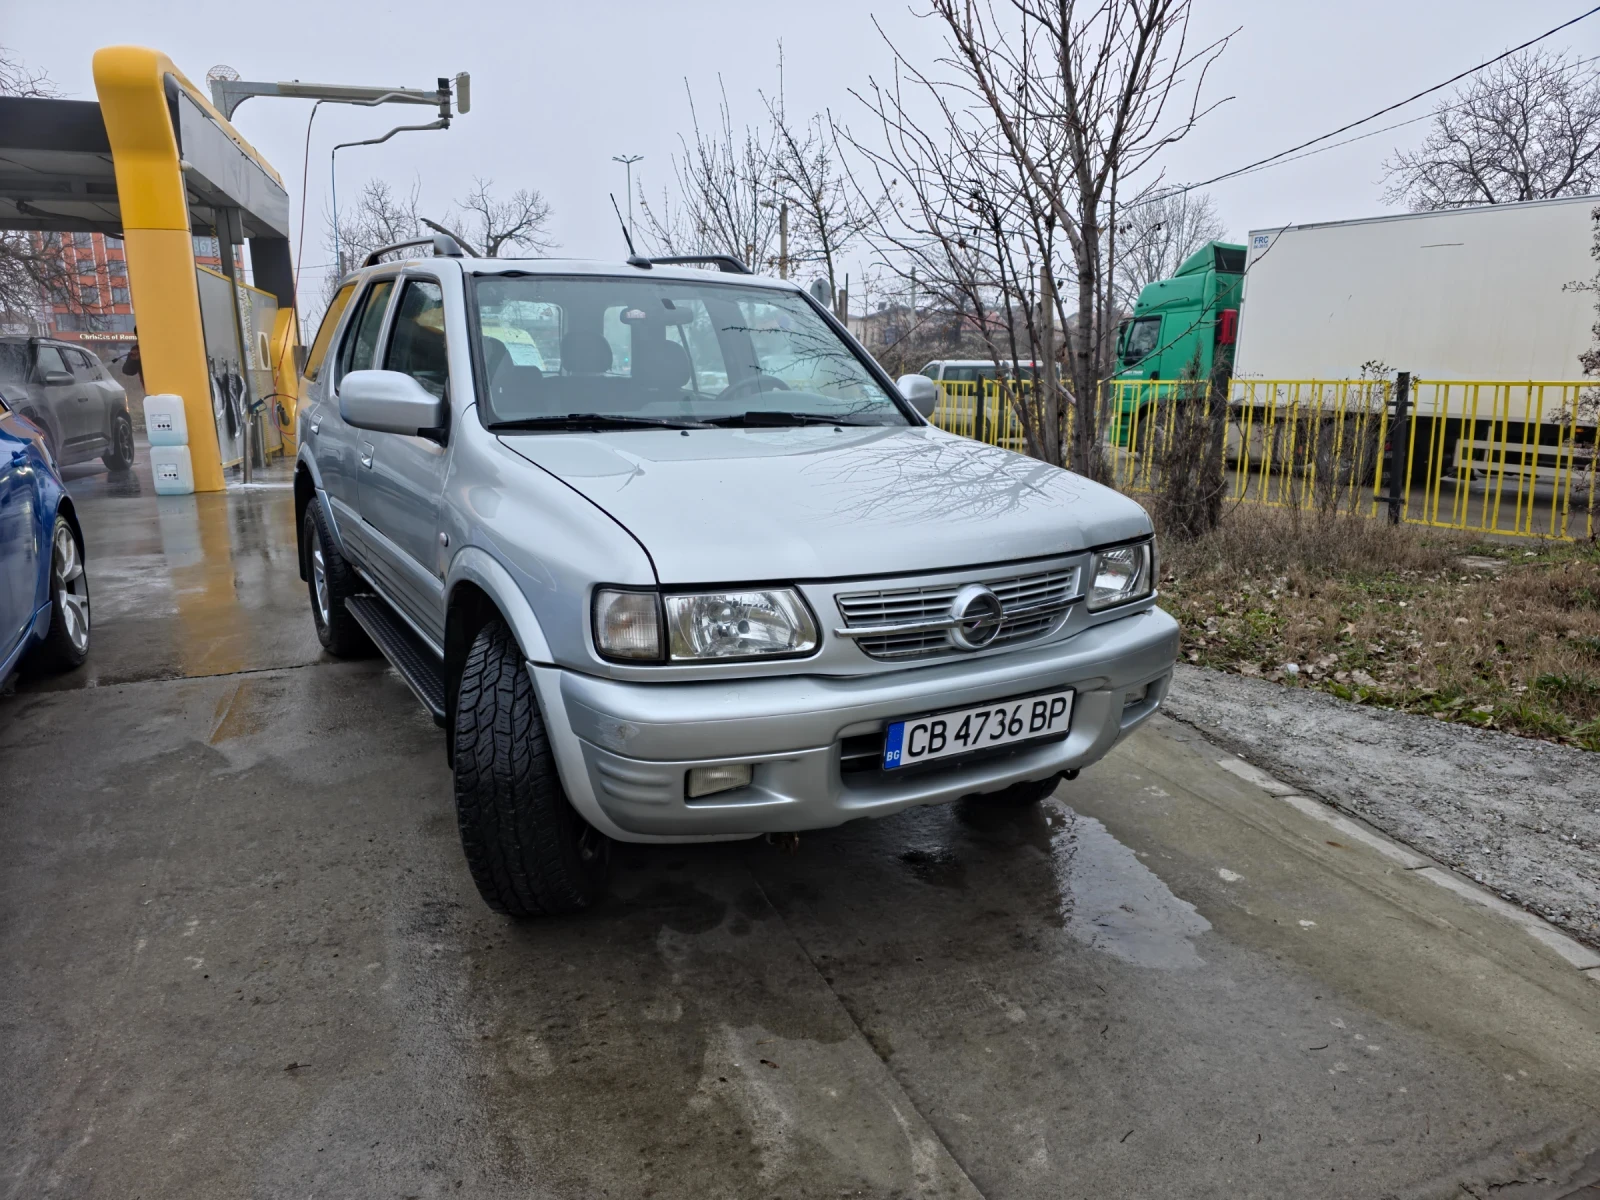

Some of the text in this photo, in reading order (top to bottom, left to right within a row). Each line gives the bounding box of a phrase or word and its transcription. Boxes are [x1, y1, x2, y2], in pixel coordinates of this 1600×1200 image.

[1254, 236, 1268, 244] FRC
[907, 697, 1067, 757] CB 4736 BP
[886, 750, 900, 762] BG
